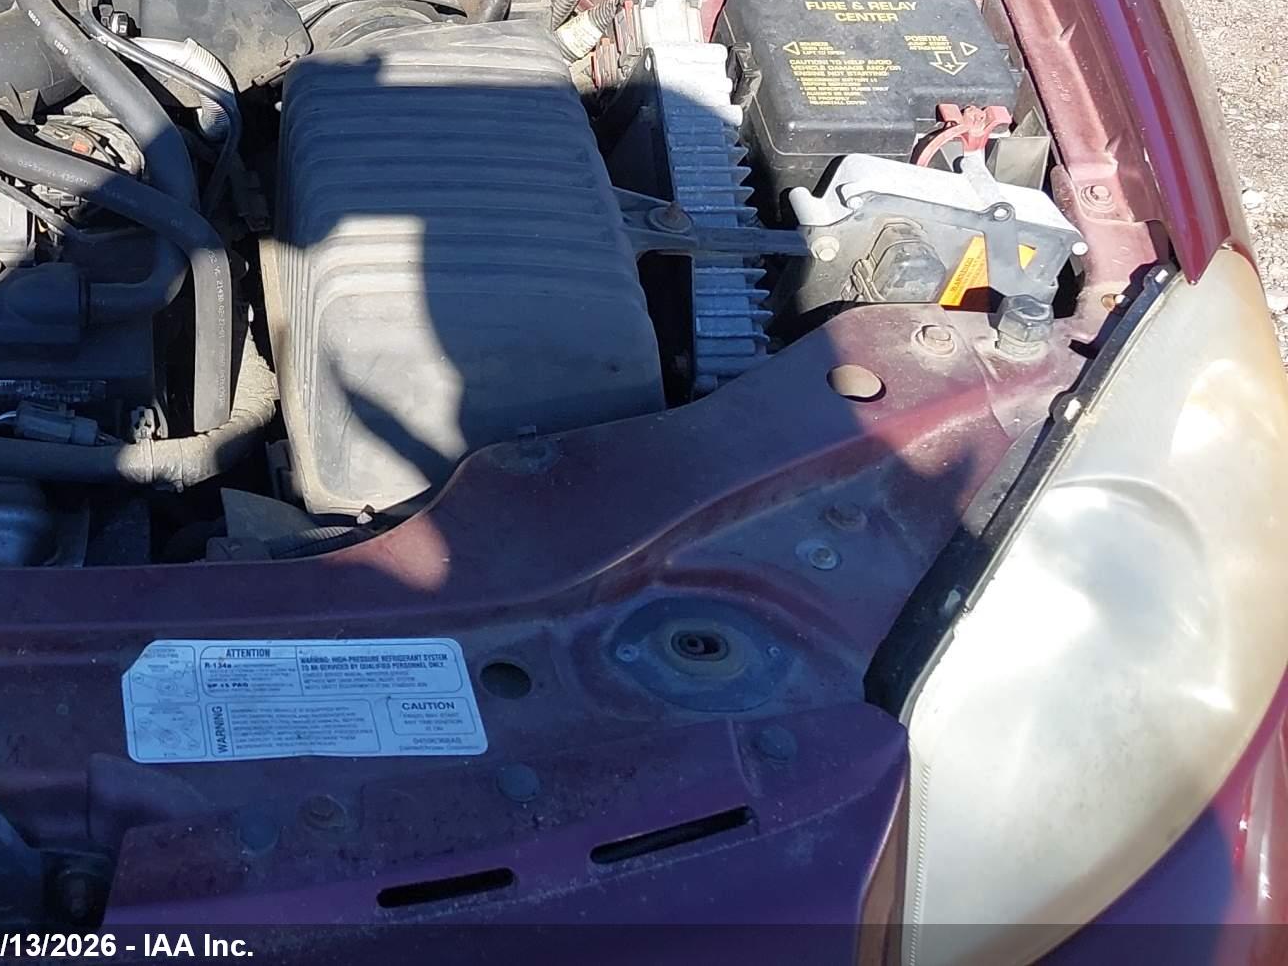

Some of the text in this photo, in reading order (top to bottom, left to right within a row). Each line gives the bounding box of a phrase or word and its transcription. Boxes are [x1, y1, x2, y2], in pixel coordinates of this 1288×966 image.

[805, 1, 917, 11] FUSE & RELAY
[835, 12, 899, 22] CENTER
[226, 648, 271, 658] ATTENTION
[423, 653, 448, 662] SYSTEM
[401, 701, 455, 710] CAUTION
[211, 705, 229, 754] WARNING
